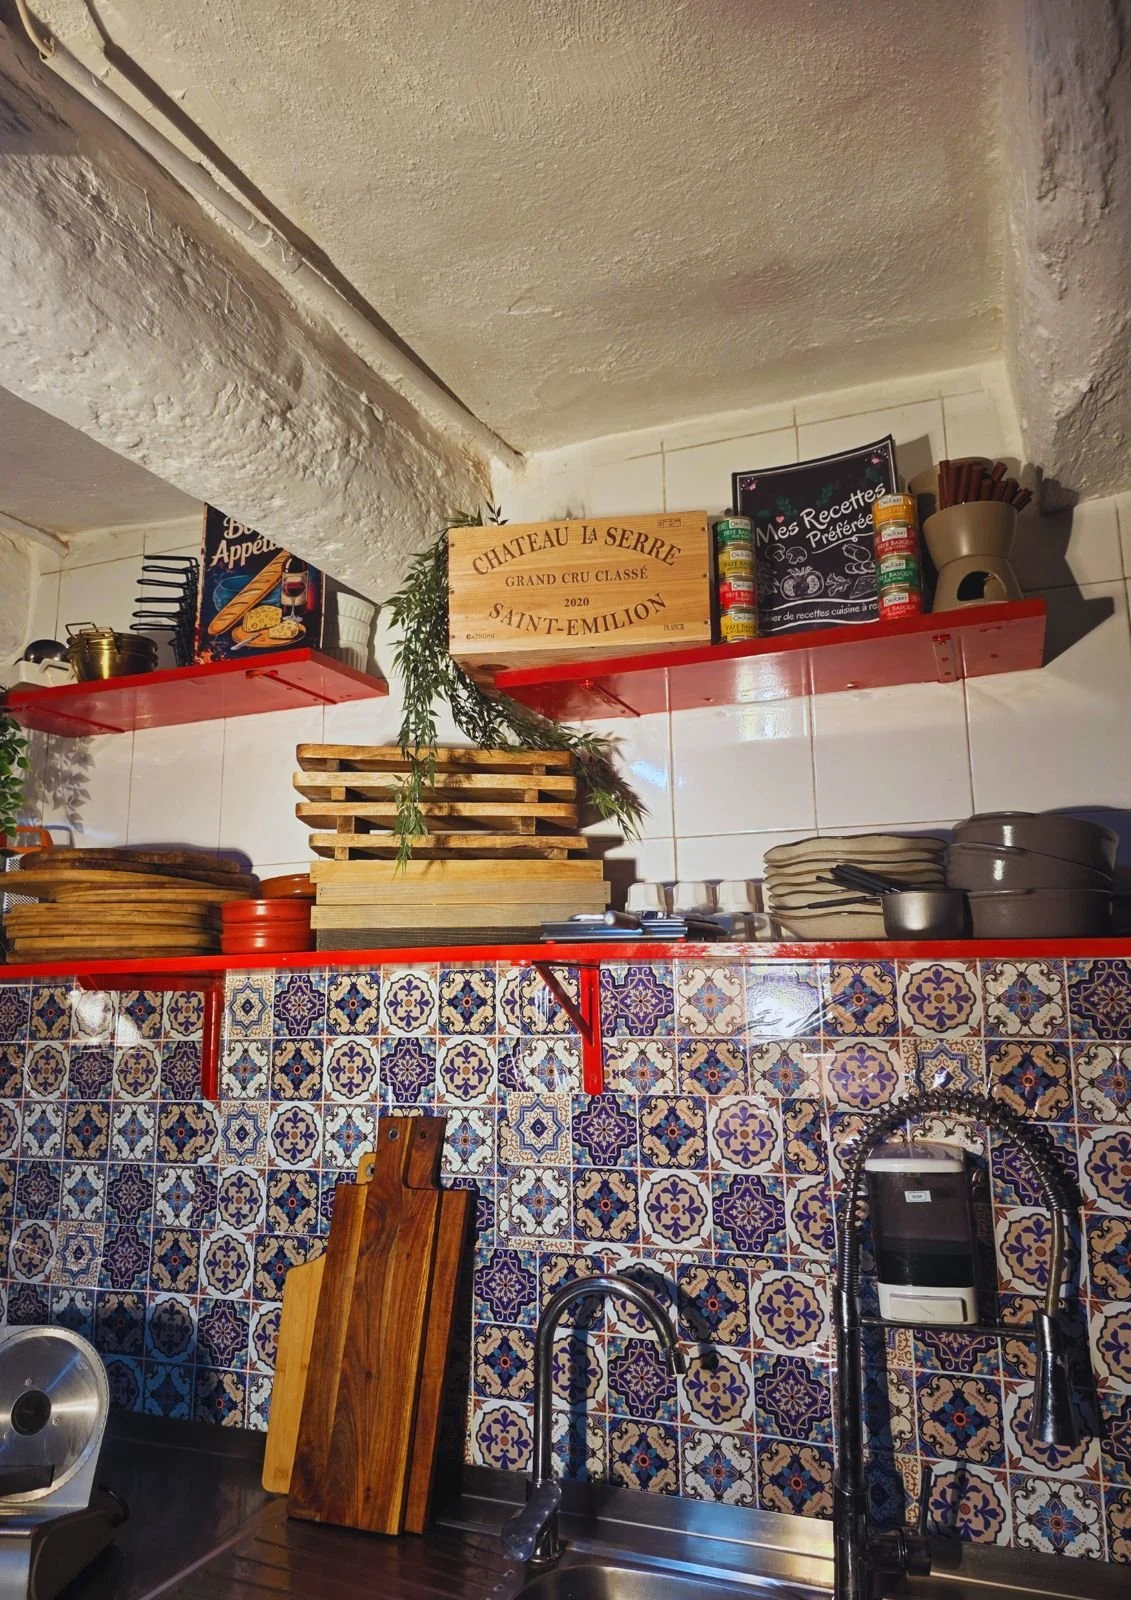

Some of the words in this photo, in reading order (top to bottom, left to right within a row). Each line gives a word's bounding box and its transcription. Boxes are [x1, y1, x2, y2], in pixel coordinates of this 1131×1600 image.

[223, 516, 255, 539] Bo
[756, 521, 799, 548] Mes
[799, 482, 887, 530] Recettes
[805, 512, 874, 549] Préférée
[471, 526, 570, 576] CHATEAU
[604, 526, 682, 567] SERRE
[504, 573, 557, 588] GRAND
[561, 571, 590, 584] CRU
[595, 565, 648, 582] CLASSÉ
[488, 592, 668, 637] SAINT-EMILION
[563, 597, 590, 608] 2020
[783, 611, 794, 621] de
[796, 609, 830, 620] recettes
[831, 604, 860, 616] cuisine
[861, 603, 868, 612] à
